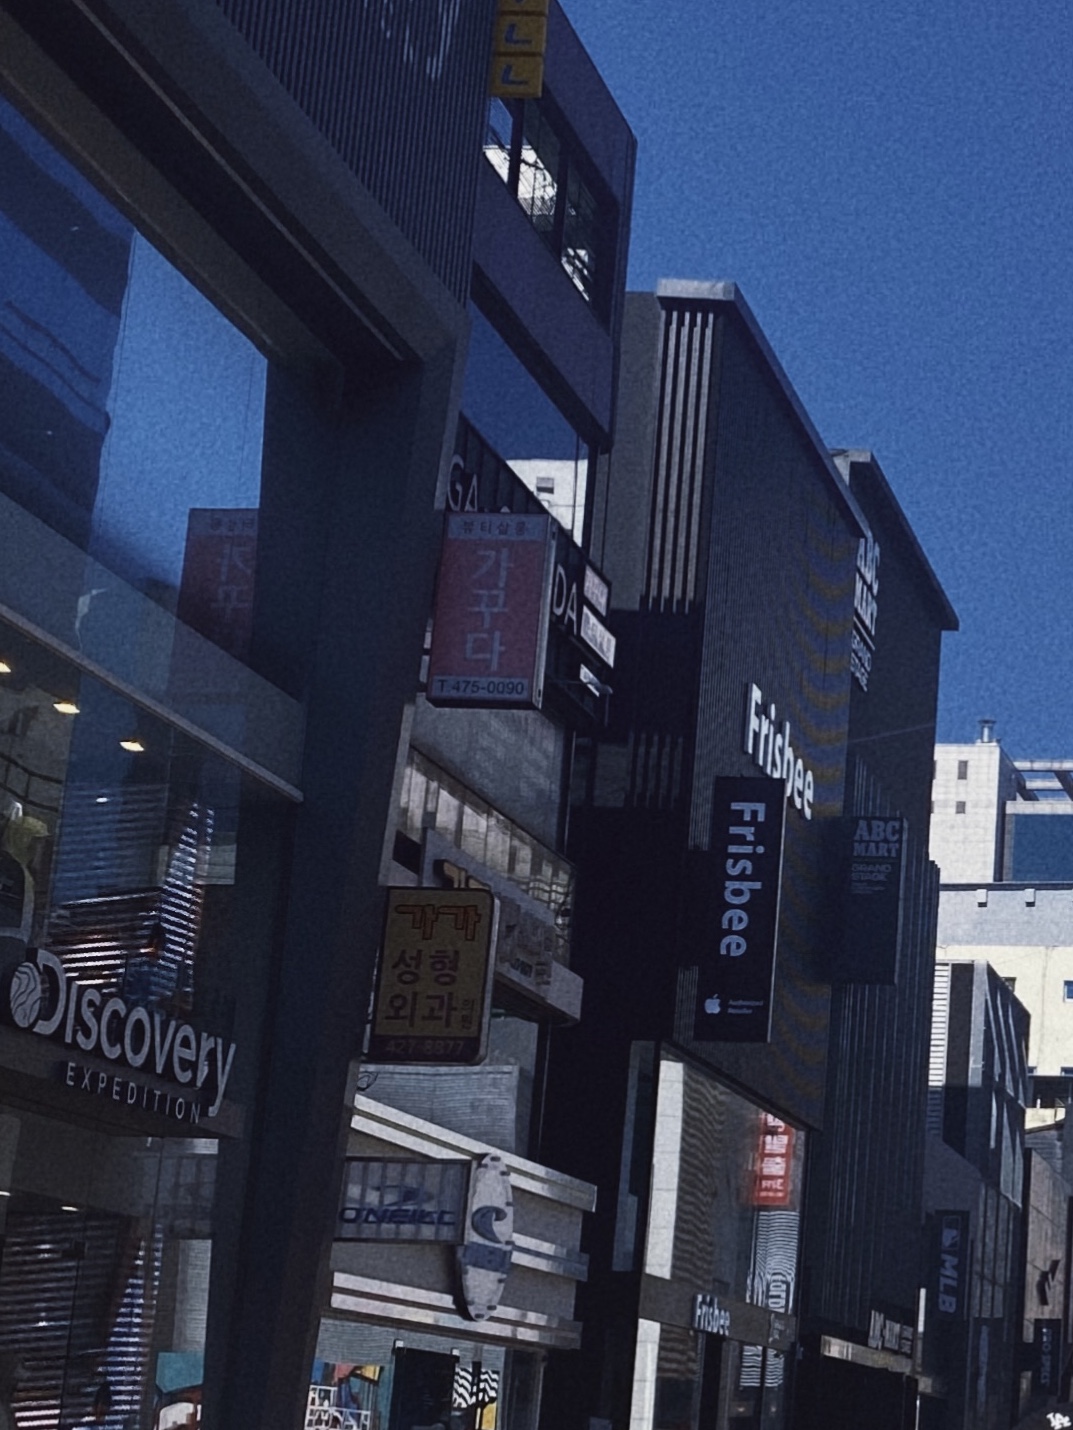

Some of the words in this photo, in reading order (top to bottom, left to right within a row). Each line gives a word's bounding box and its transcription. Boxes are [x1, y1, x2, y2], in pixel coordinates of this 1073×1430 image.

[465, 547, 513, 672] 가꾸다
[743, 681, 815, 821] Frisbee
[853, 820, 900, 842] ABC
[853, 842, 899, 858] MART
[719, 801, 766, 957] Frisbee
[392, 949, 460, 986] 성형
[383, 991, 458, 1029] 외과
[65, 1061, 201, 1124] EXPEDITION
[938, 1256, 960, 1314] MLB
[693, 1293, 731, 1337] Frisbee
